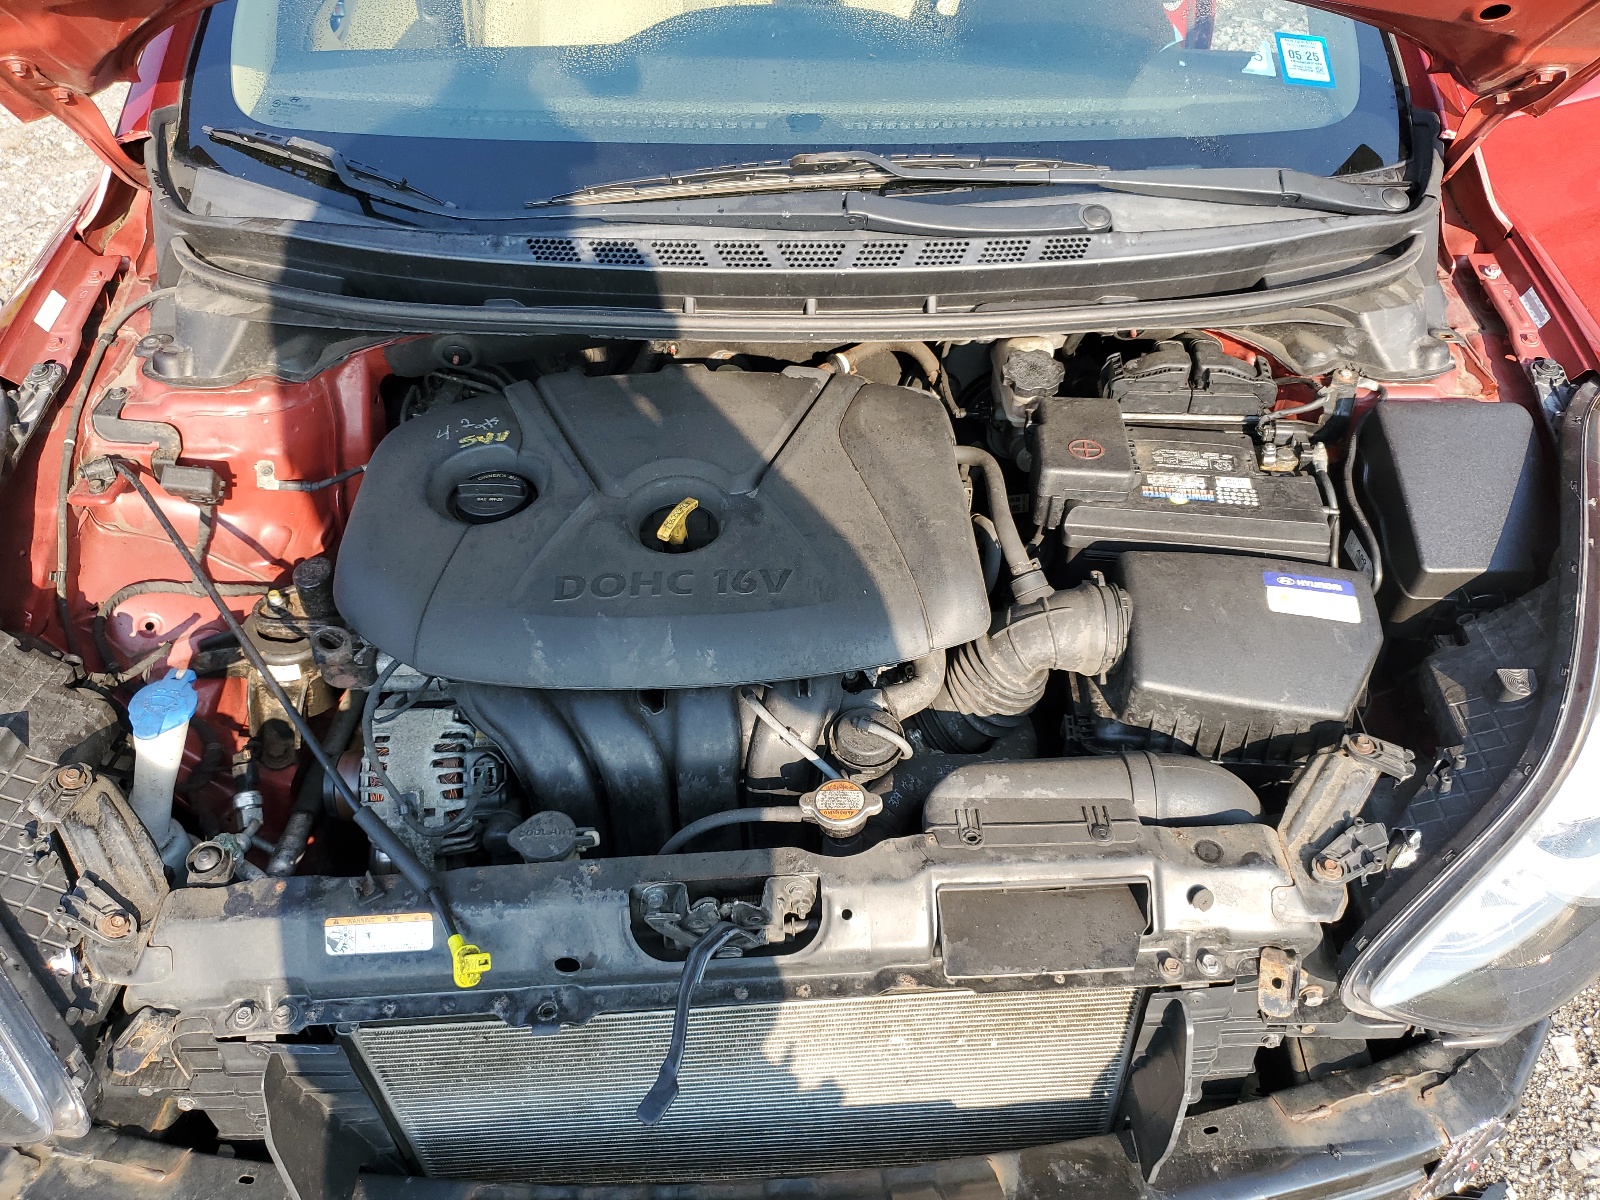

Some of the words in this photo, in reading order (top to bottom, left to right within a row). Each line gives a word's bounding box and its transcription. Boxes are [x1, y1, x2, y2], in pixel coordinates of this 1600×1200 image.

[1288, 49, 1302, 60] 05
[1305, 51, 1320, 61] 25
[553, 569, 694, 602] DOHC
[713, 568, 793, 595] 16V
